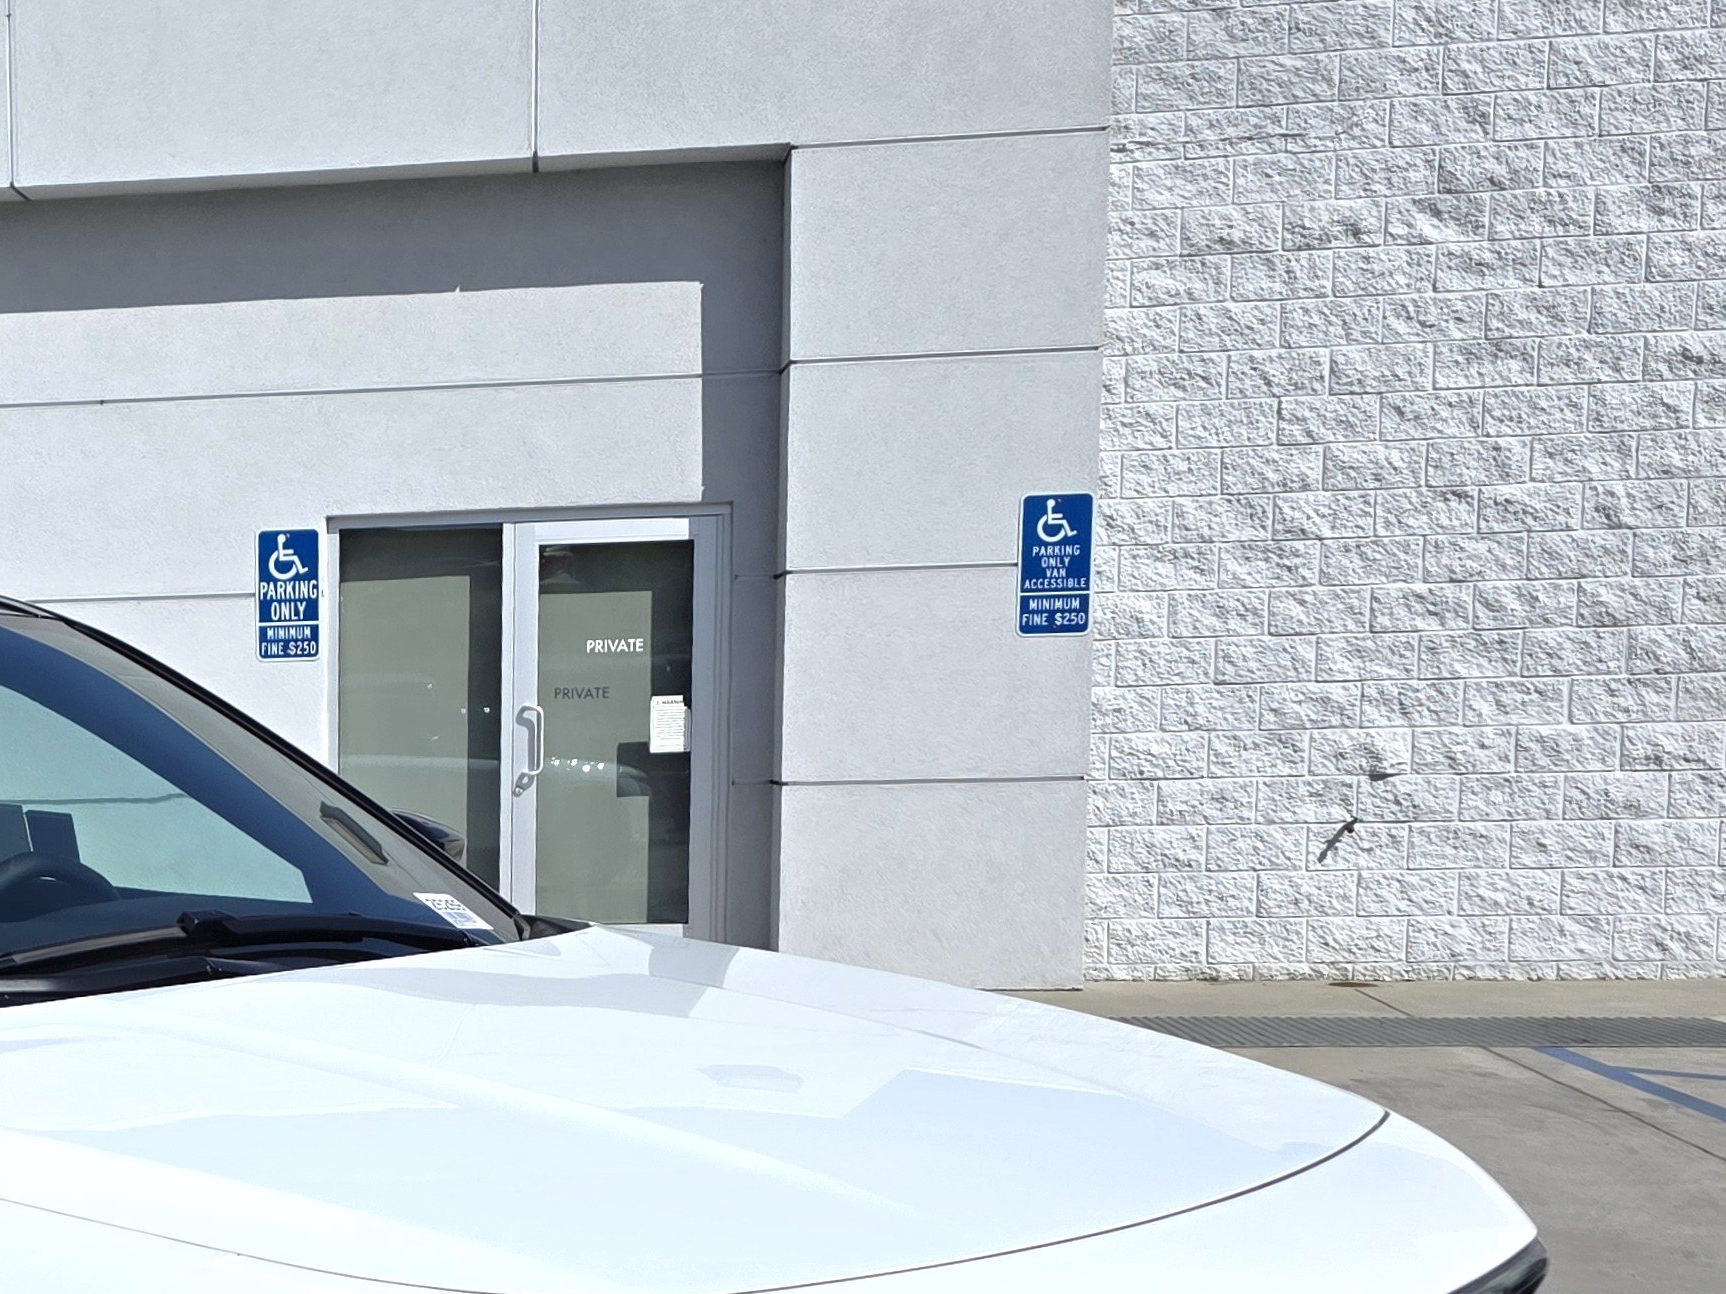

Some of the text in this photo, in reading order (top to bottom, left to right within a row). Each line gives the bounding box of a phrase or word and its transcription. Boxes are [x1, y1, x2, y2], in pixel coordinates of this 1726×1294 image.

[1032, 545, 1081, 557] PARKING
[1041, 557, 1071, 568] ONLY
[1045, 568, 1067, 578] VAN
[1024, 578, 1087, 589] ACCESSIBLE
[260, 580, 317, 600] PARKING
[1029, 598, 1080, 610] MINIMUM
[270, 601, 307, 621] ONLY
[1022, 613, 1086, 626] FINE $250
[267, 626, 311, 640] MINIMUM
[261, 641, 317, 656] FINE $250
[586, 638, 644, 653] PRIVATE
[554, 687, 610, 699] PRIVATE
